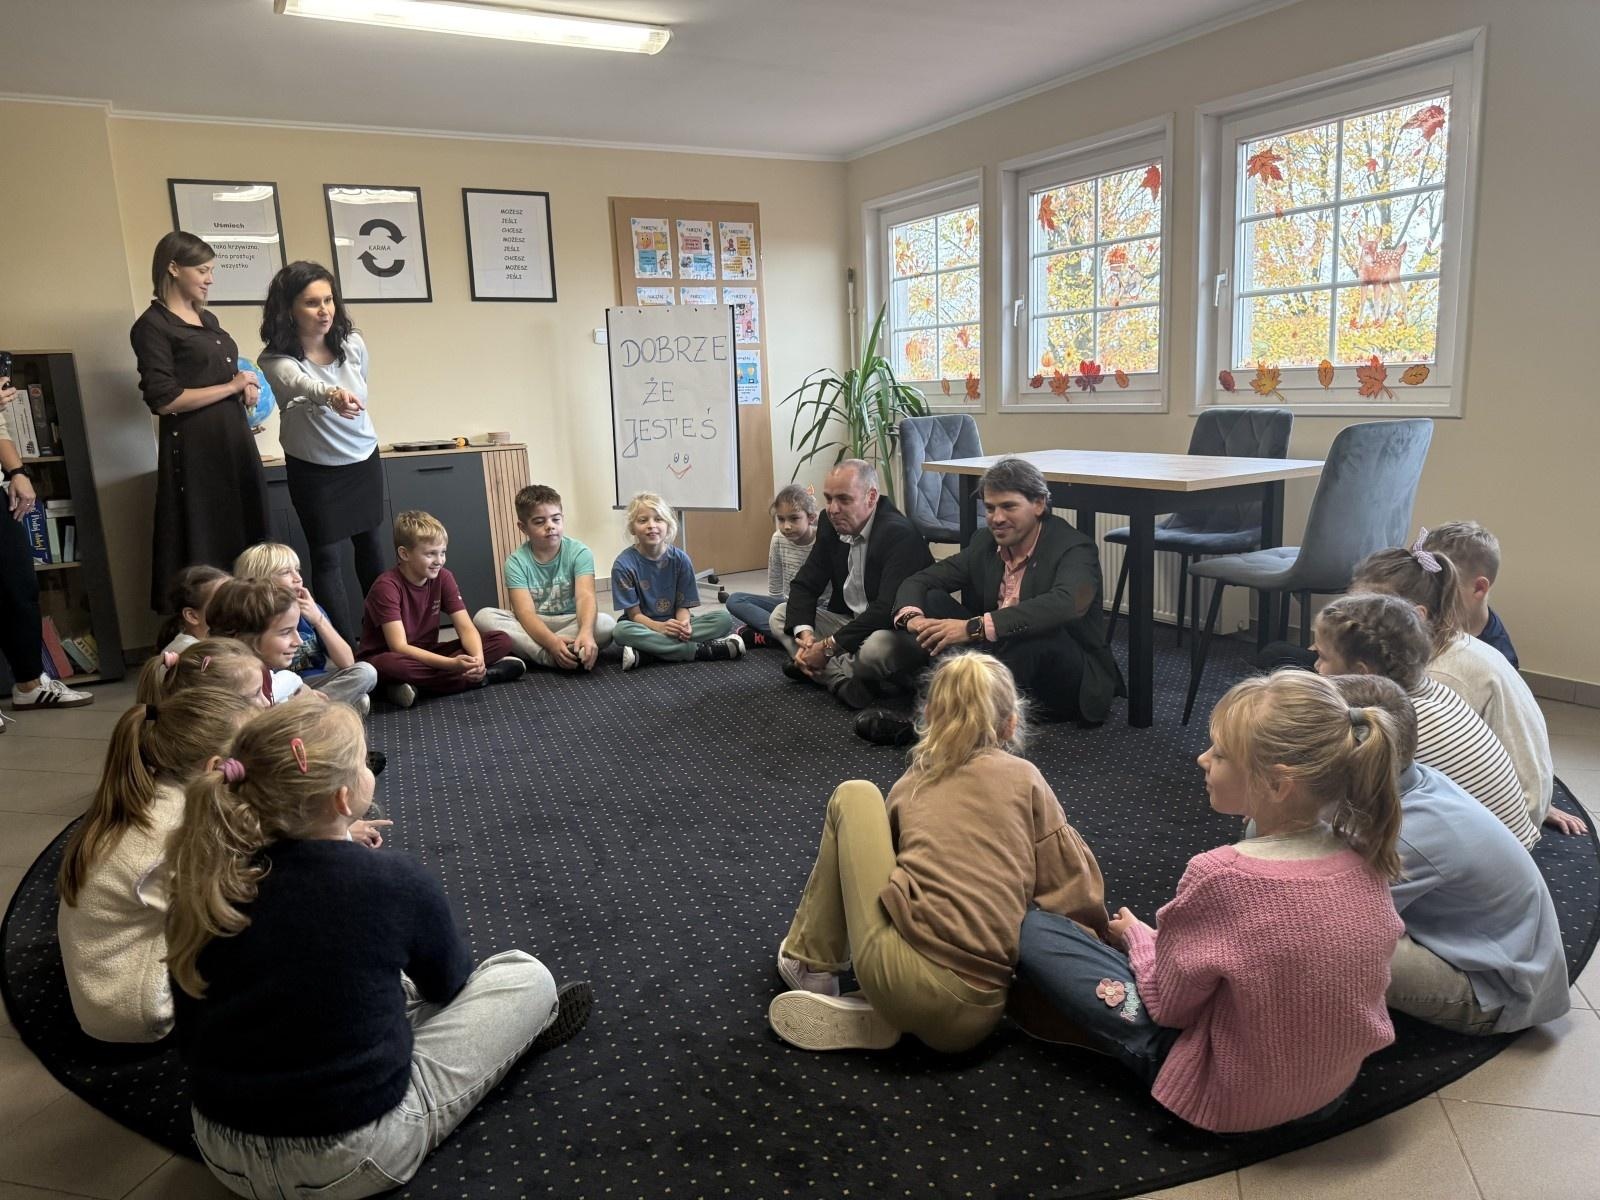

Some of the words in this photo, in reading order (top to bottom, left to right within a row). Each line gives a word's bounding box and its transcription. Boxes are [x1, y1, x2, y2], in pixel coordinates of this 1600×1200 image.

[620, 335, 727, 368] DOBRZE
[642, 376, 675, 406] ŻE
[622, 407, 718, 458] JESTEŚ
